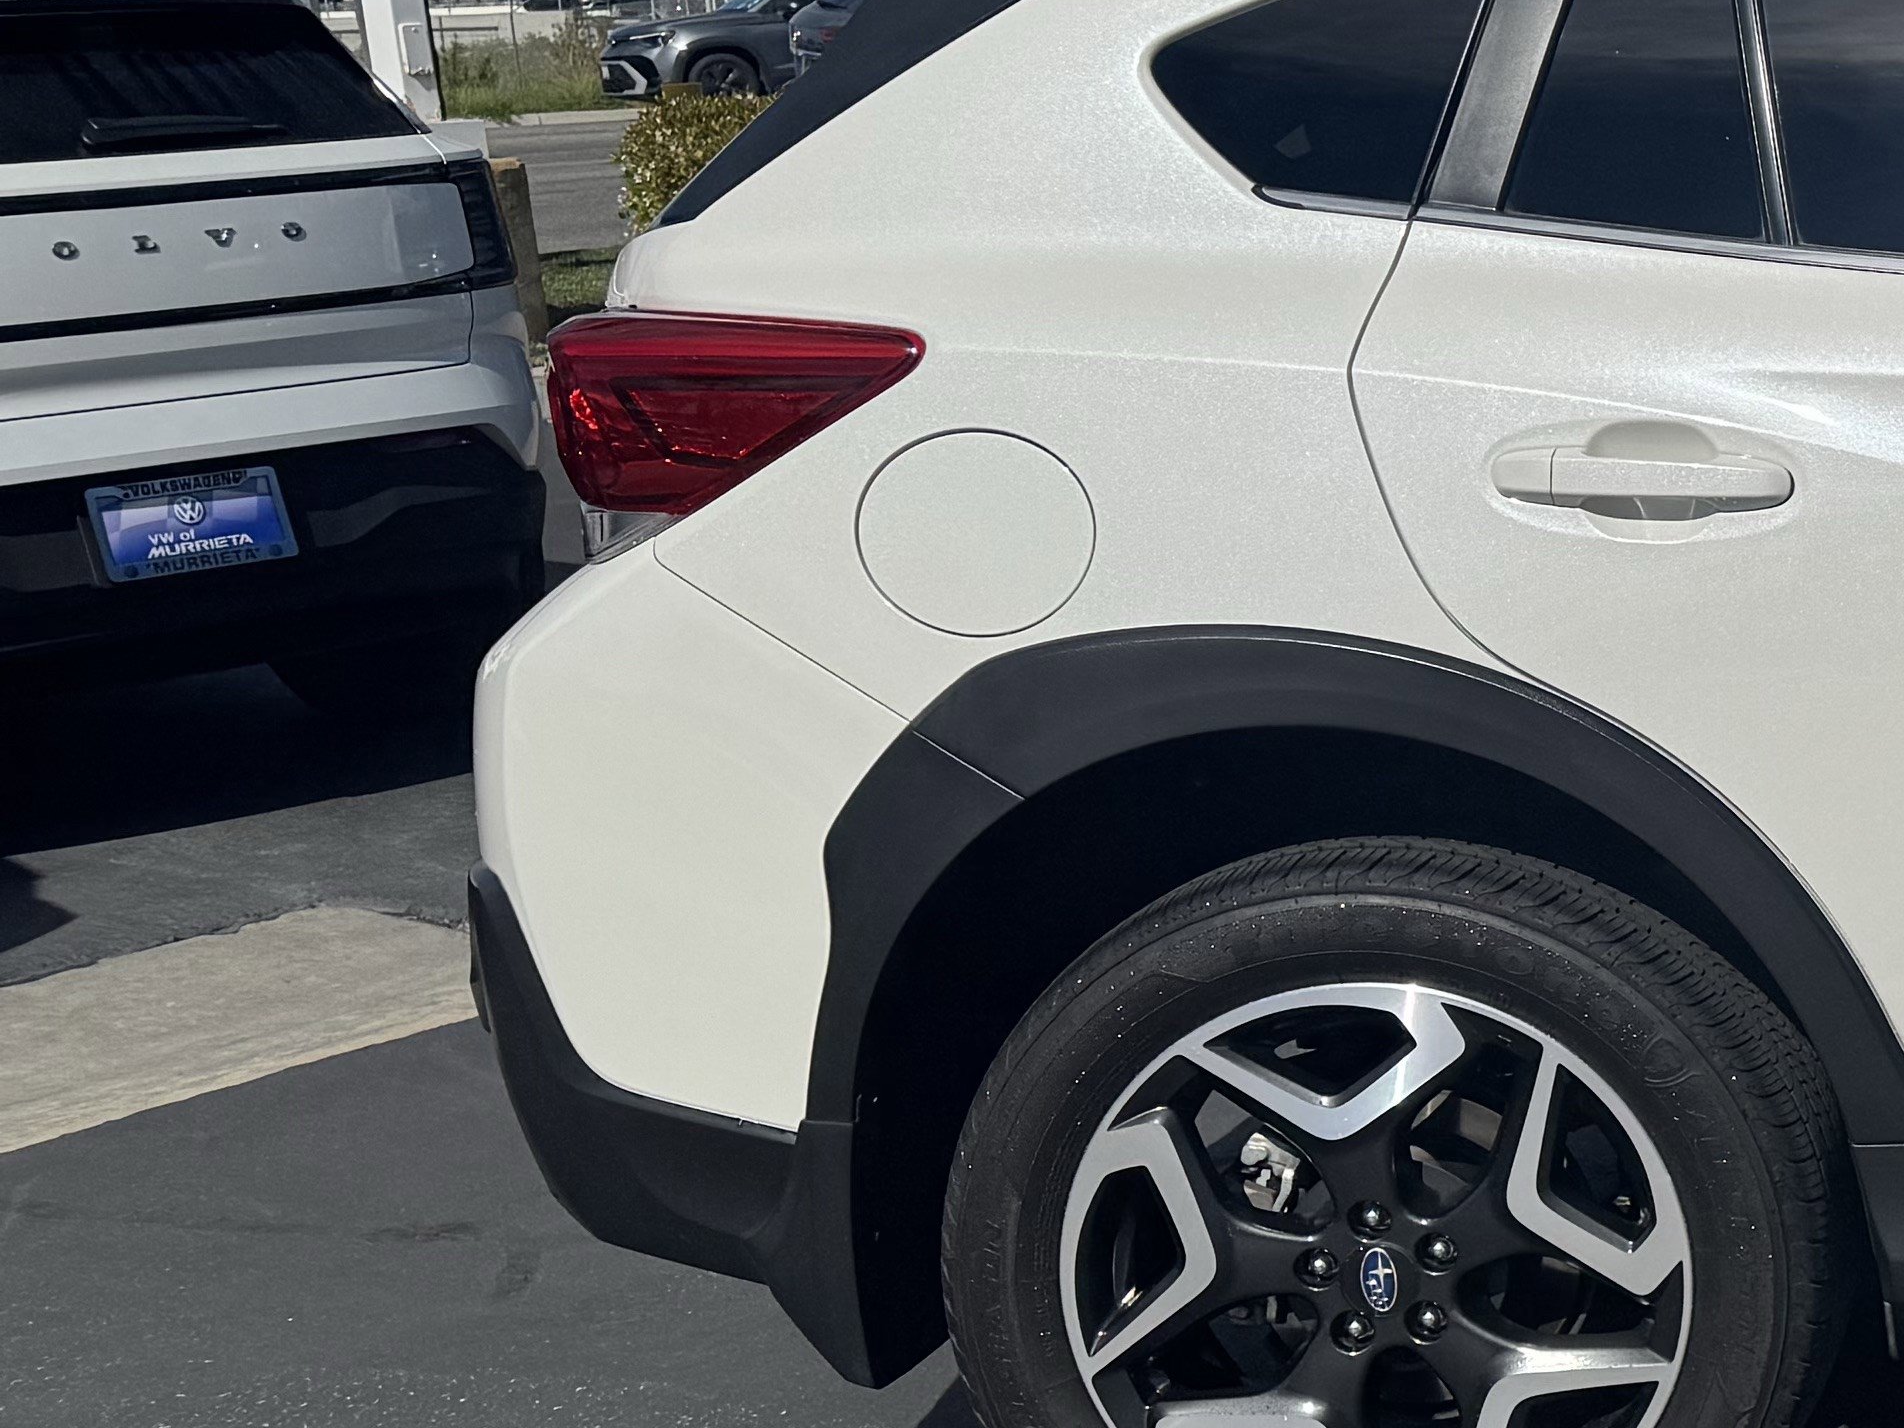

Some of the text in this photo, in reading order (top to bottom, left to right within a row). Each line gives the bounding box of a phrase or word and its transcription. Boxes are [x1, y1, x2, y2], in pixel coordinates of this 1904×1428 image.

[51, 221, 307, 261] OLVO
[147, 532, 175, 546] VW
[147, 533, 254, 560] MURRIETA
